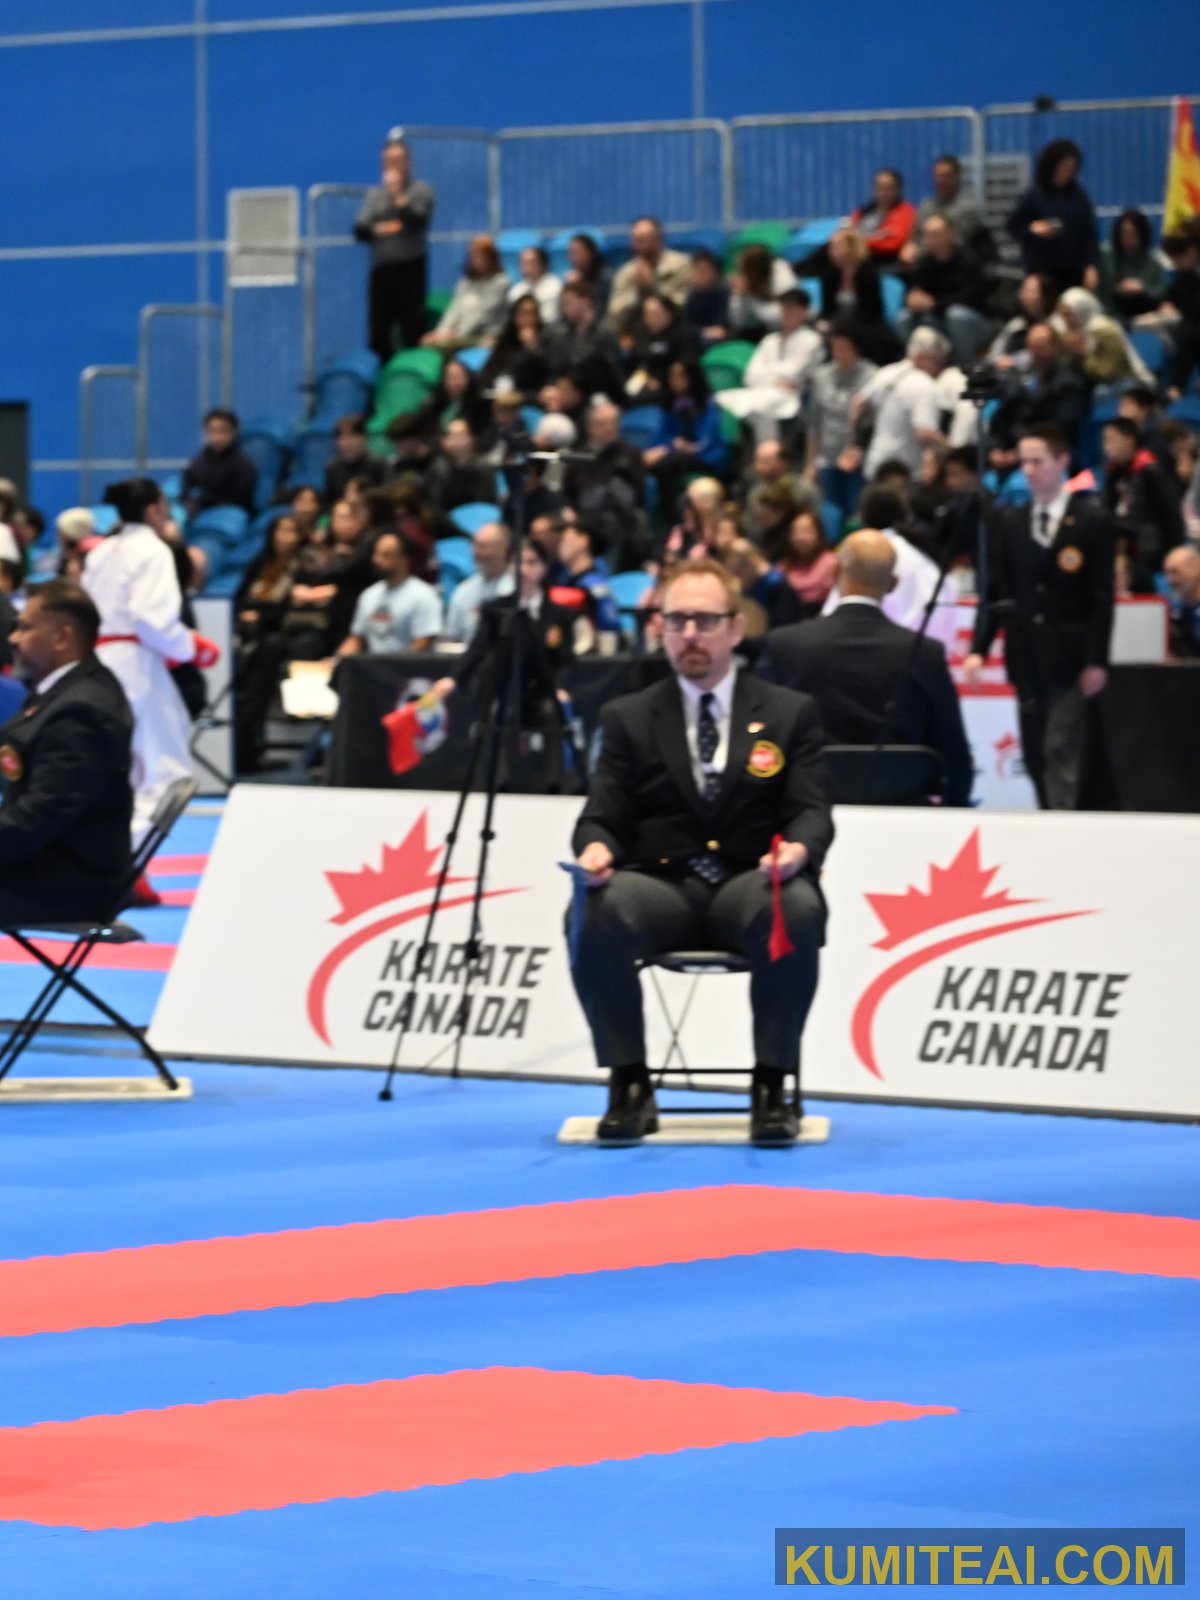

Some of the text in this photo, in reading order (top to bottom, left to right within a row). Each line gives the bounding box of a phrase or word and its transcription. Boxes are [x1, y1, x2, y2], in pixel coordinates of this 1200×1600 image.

[379, 939, 553, 988] KARATE
[362, 990, 530, 1039] CANADA
[934, 966, 1130, 1018] KARATE
[918, 1020, 1110, 1072] CANADA
